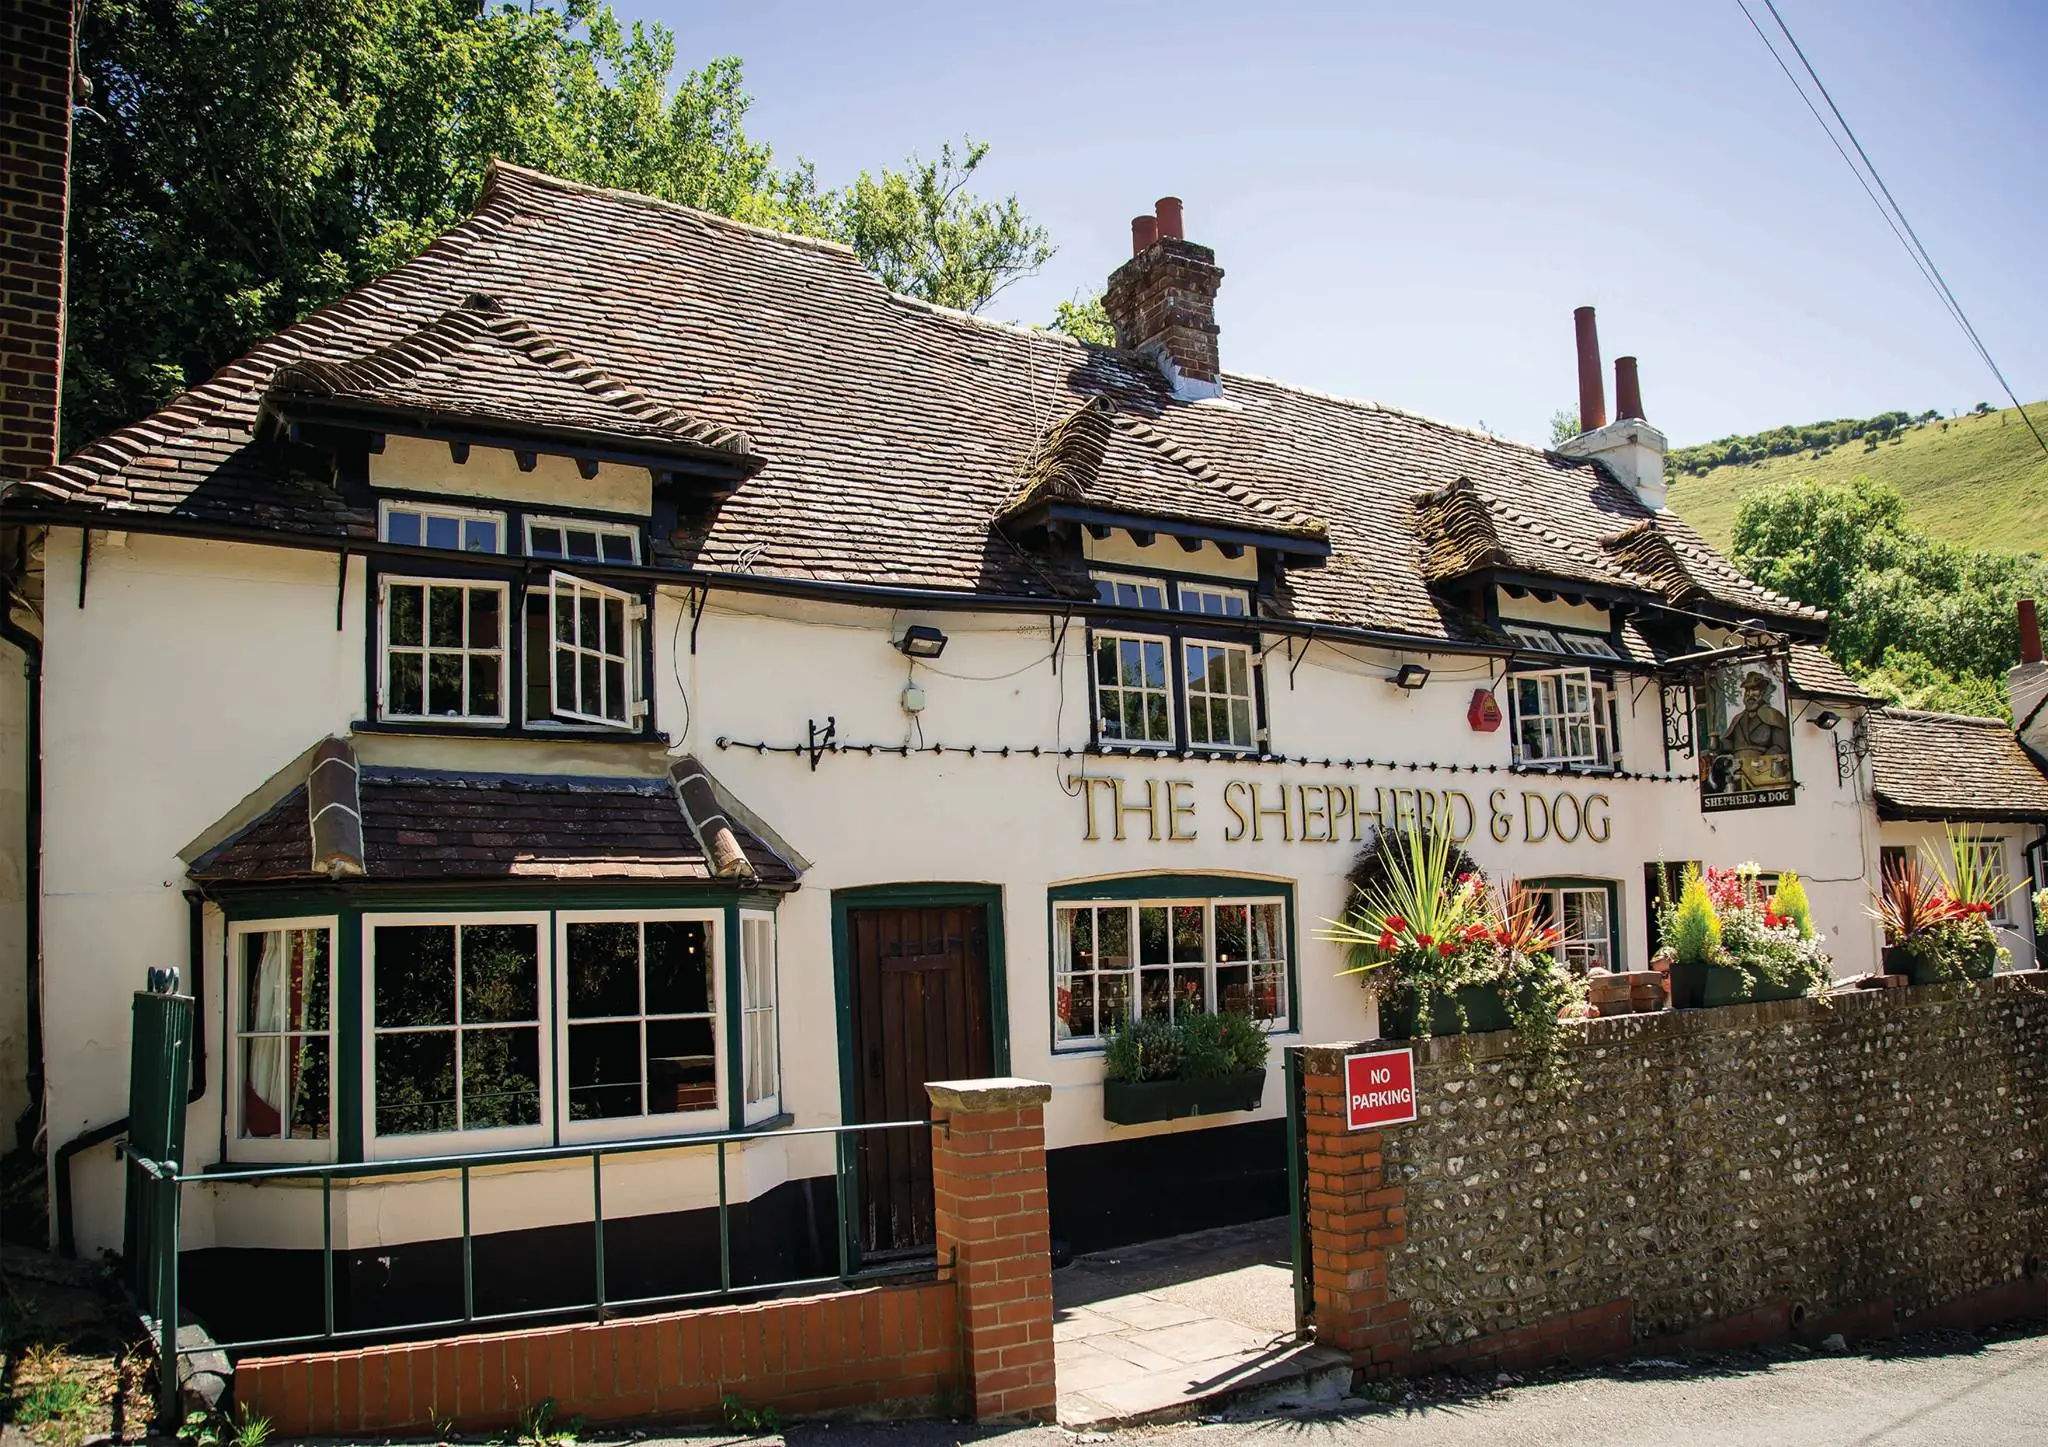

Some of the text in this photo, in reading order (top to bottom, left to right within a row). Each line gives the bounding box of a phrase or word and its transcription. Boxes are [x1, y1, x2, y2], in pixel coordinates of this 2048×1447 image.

[1068, 774, 1612, 843] THE SHEPHERD & DOG
[1704, 791, 1789, 807] SHEPHERD & DOG
[1370, 1068, 1390, 1084] NO
[1352, 1088, 1410, 1110] PARKING
